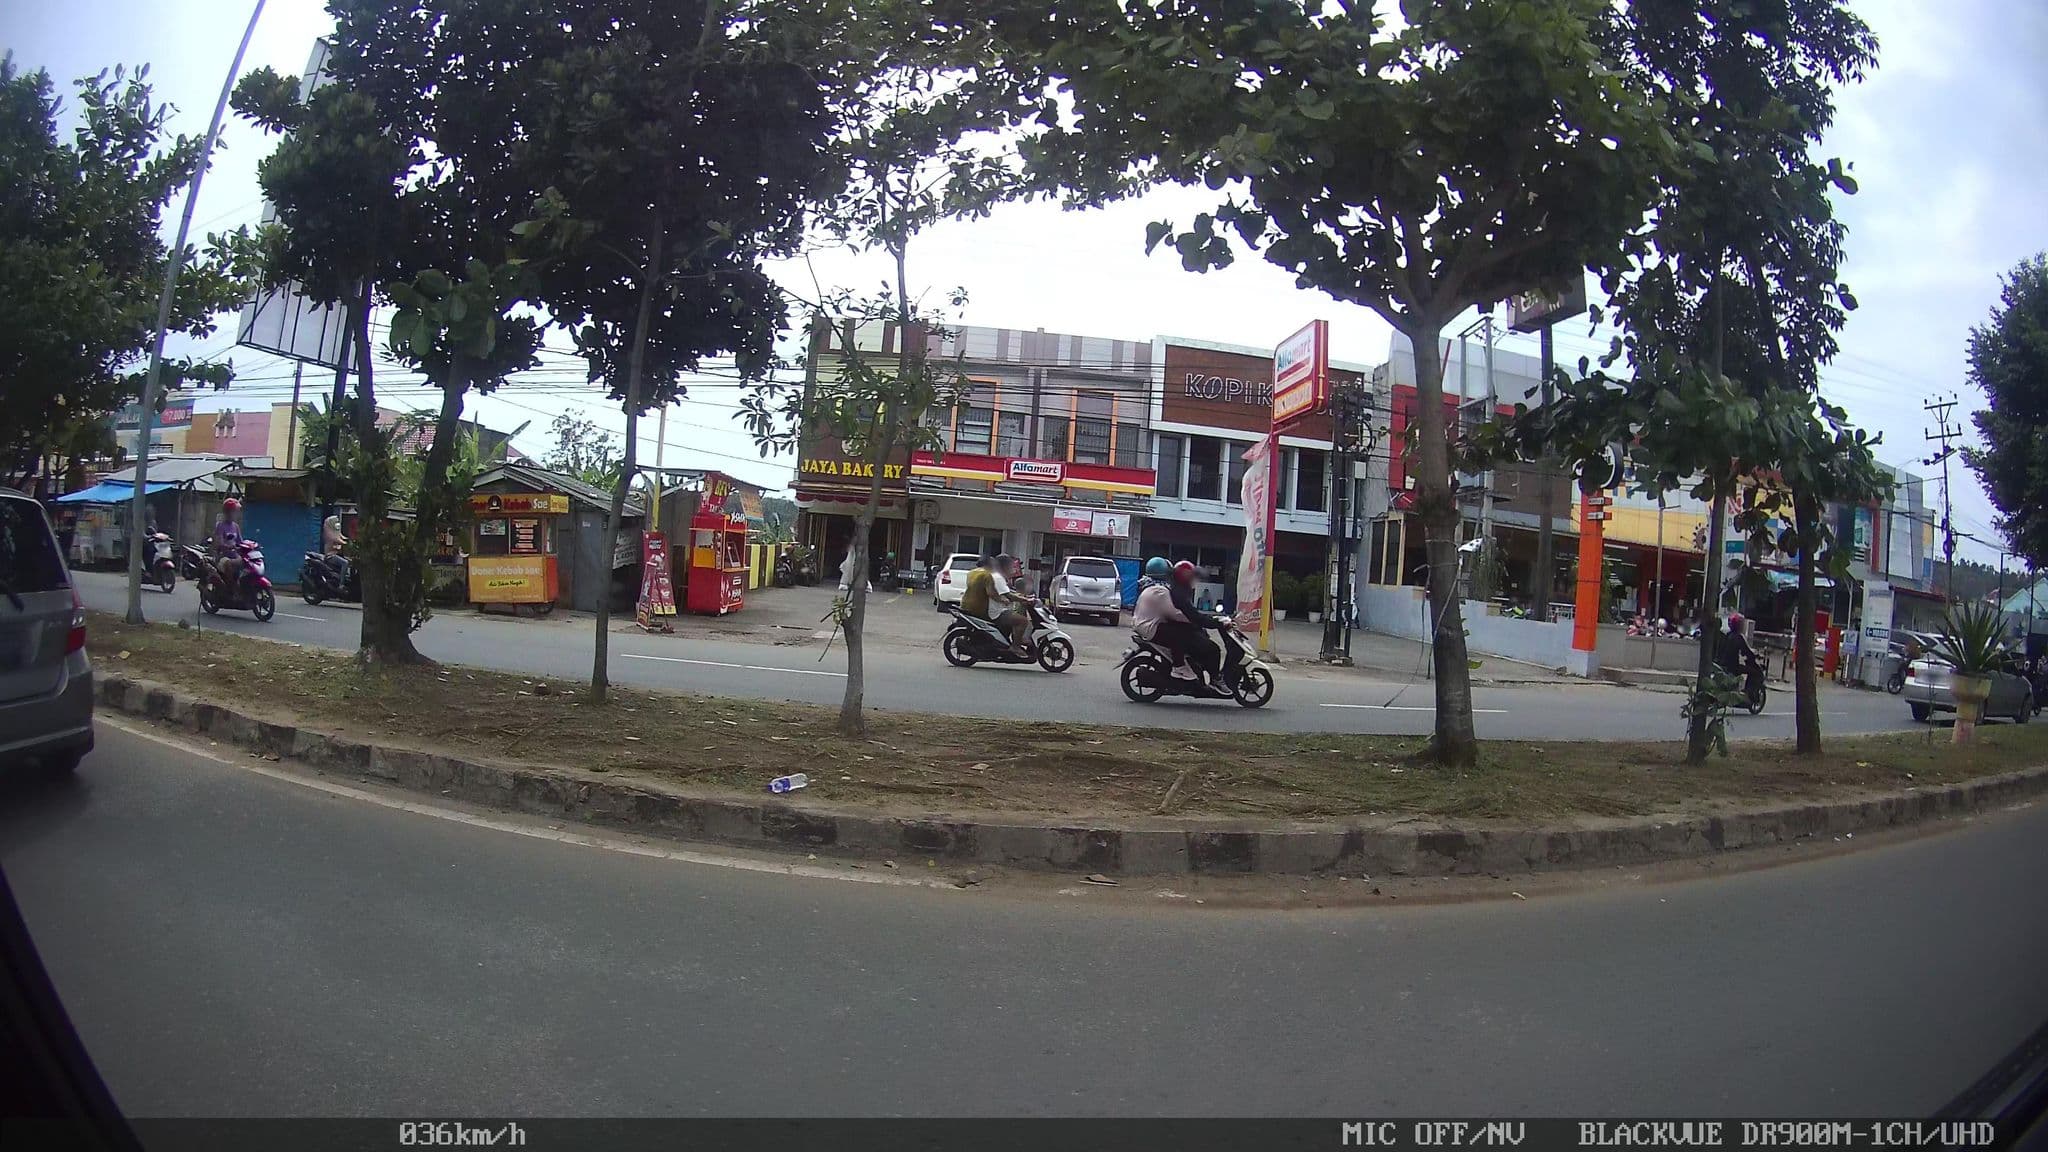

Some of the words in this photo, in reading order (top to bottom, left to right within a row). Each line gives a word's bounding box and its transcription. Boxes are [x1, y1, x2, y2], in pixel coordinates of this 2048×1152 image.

[801, 459, 838, 475] JAYA
[842, 462, 904, 479] BAKRY
[1012, 461, 1058, 474] Alfamart
[532, 498, 548, 509] Sae
